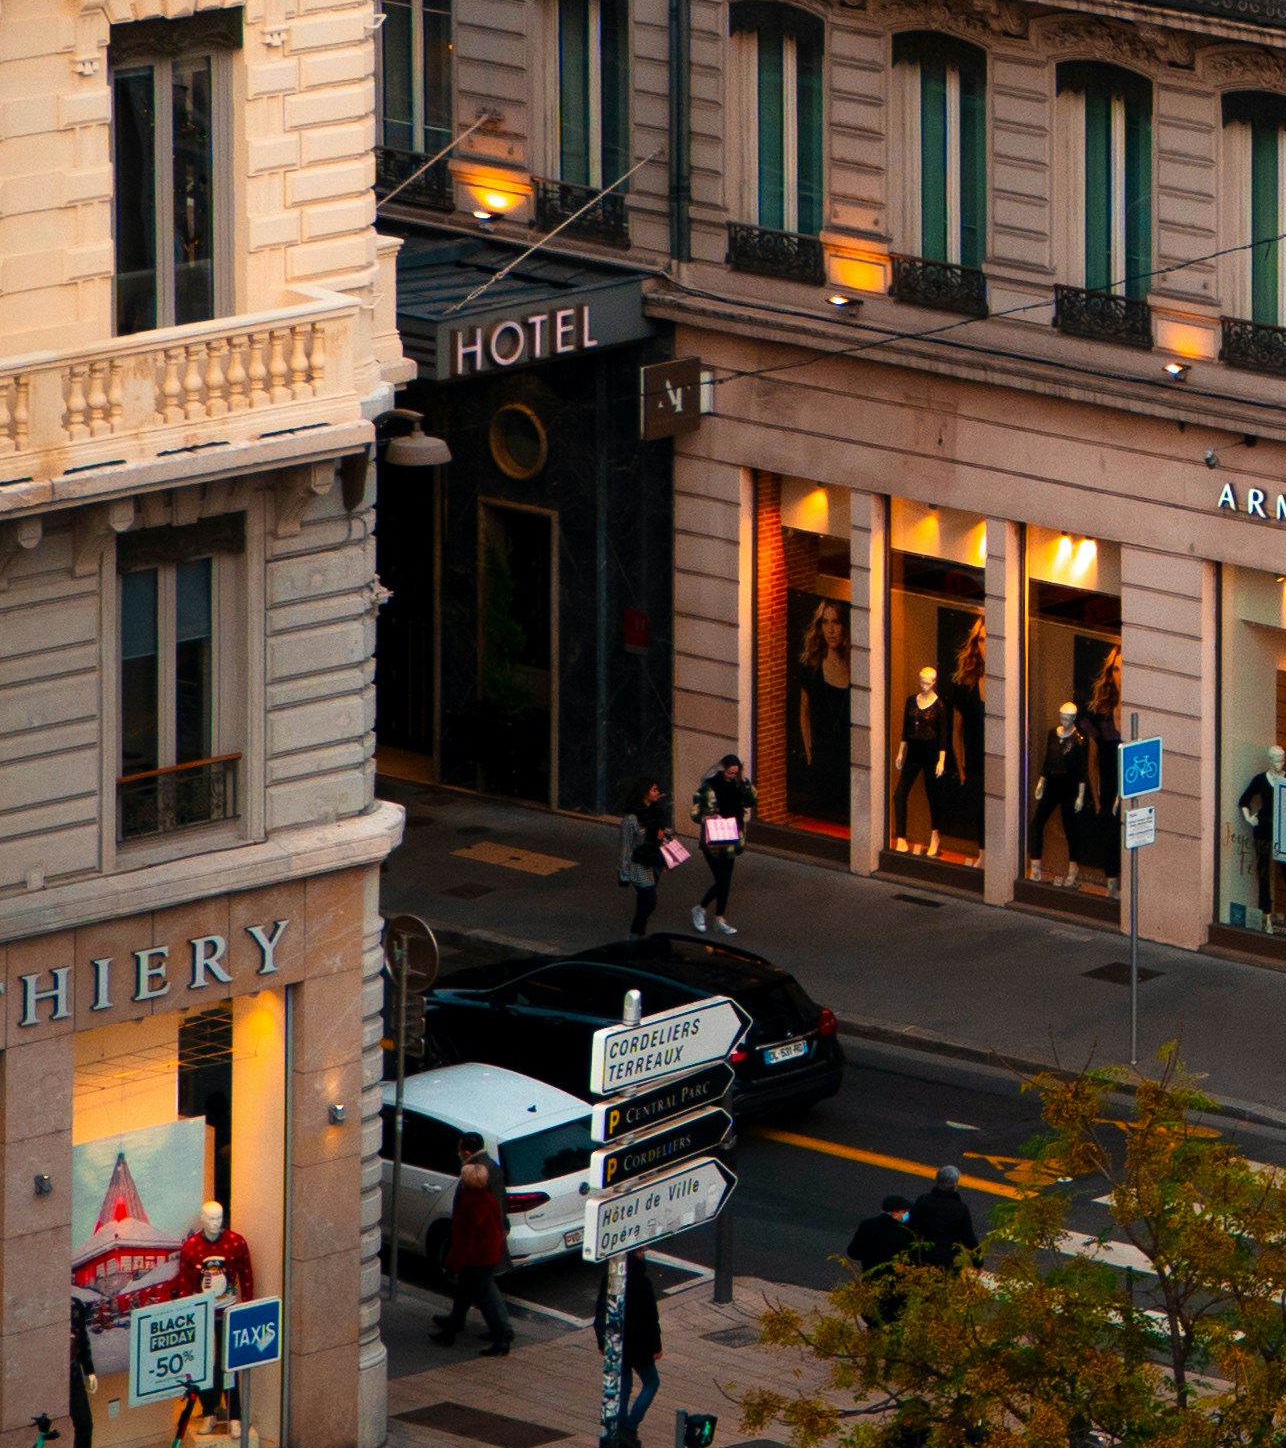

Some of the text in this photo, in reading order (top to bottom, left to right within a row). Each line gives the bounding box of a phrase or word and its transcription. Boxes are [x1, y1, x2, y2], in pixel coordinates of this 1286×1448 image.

[453, 305, 599, 376] HOTEL
[0, 919, 289, 1027] HIERY
[609, 1018, 701, 1059] CORDELIERS
[609, 1045, 684, 1082] TERREAUX
[609, 1081, 711, 1135] P CENTRAL PARC
[607, 1135, 692, 1183] P CORDELIERS
[601, 1177, 700, 1228] Hôtel de Ville
[601, 1223, 641, 1251] Opéra
[150, 1312, 195, 1335] BLACK
[151, 1328, 195, 1350] FRIDAY
[232, 1322, 276, 1349] TAXIS
[149, 1349, 195, 1378] -50%
